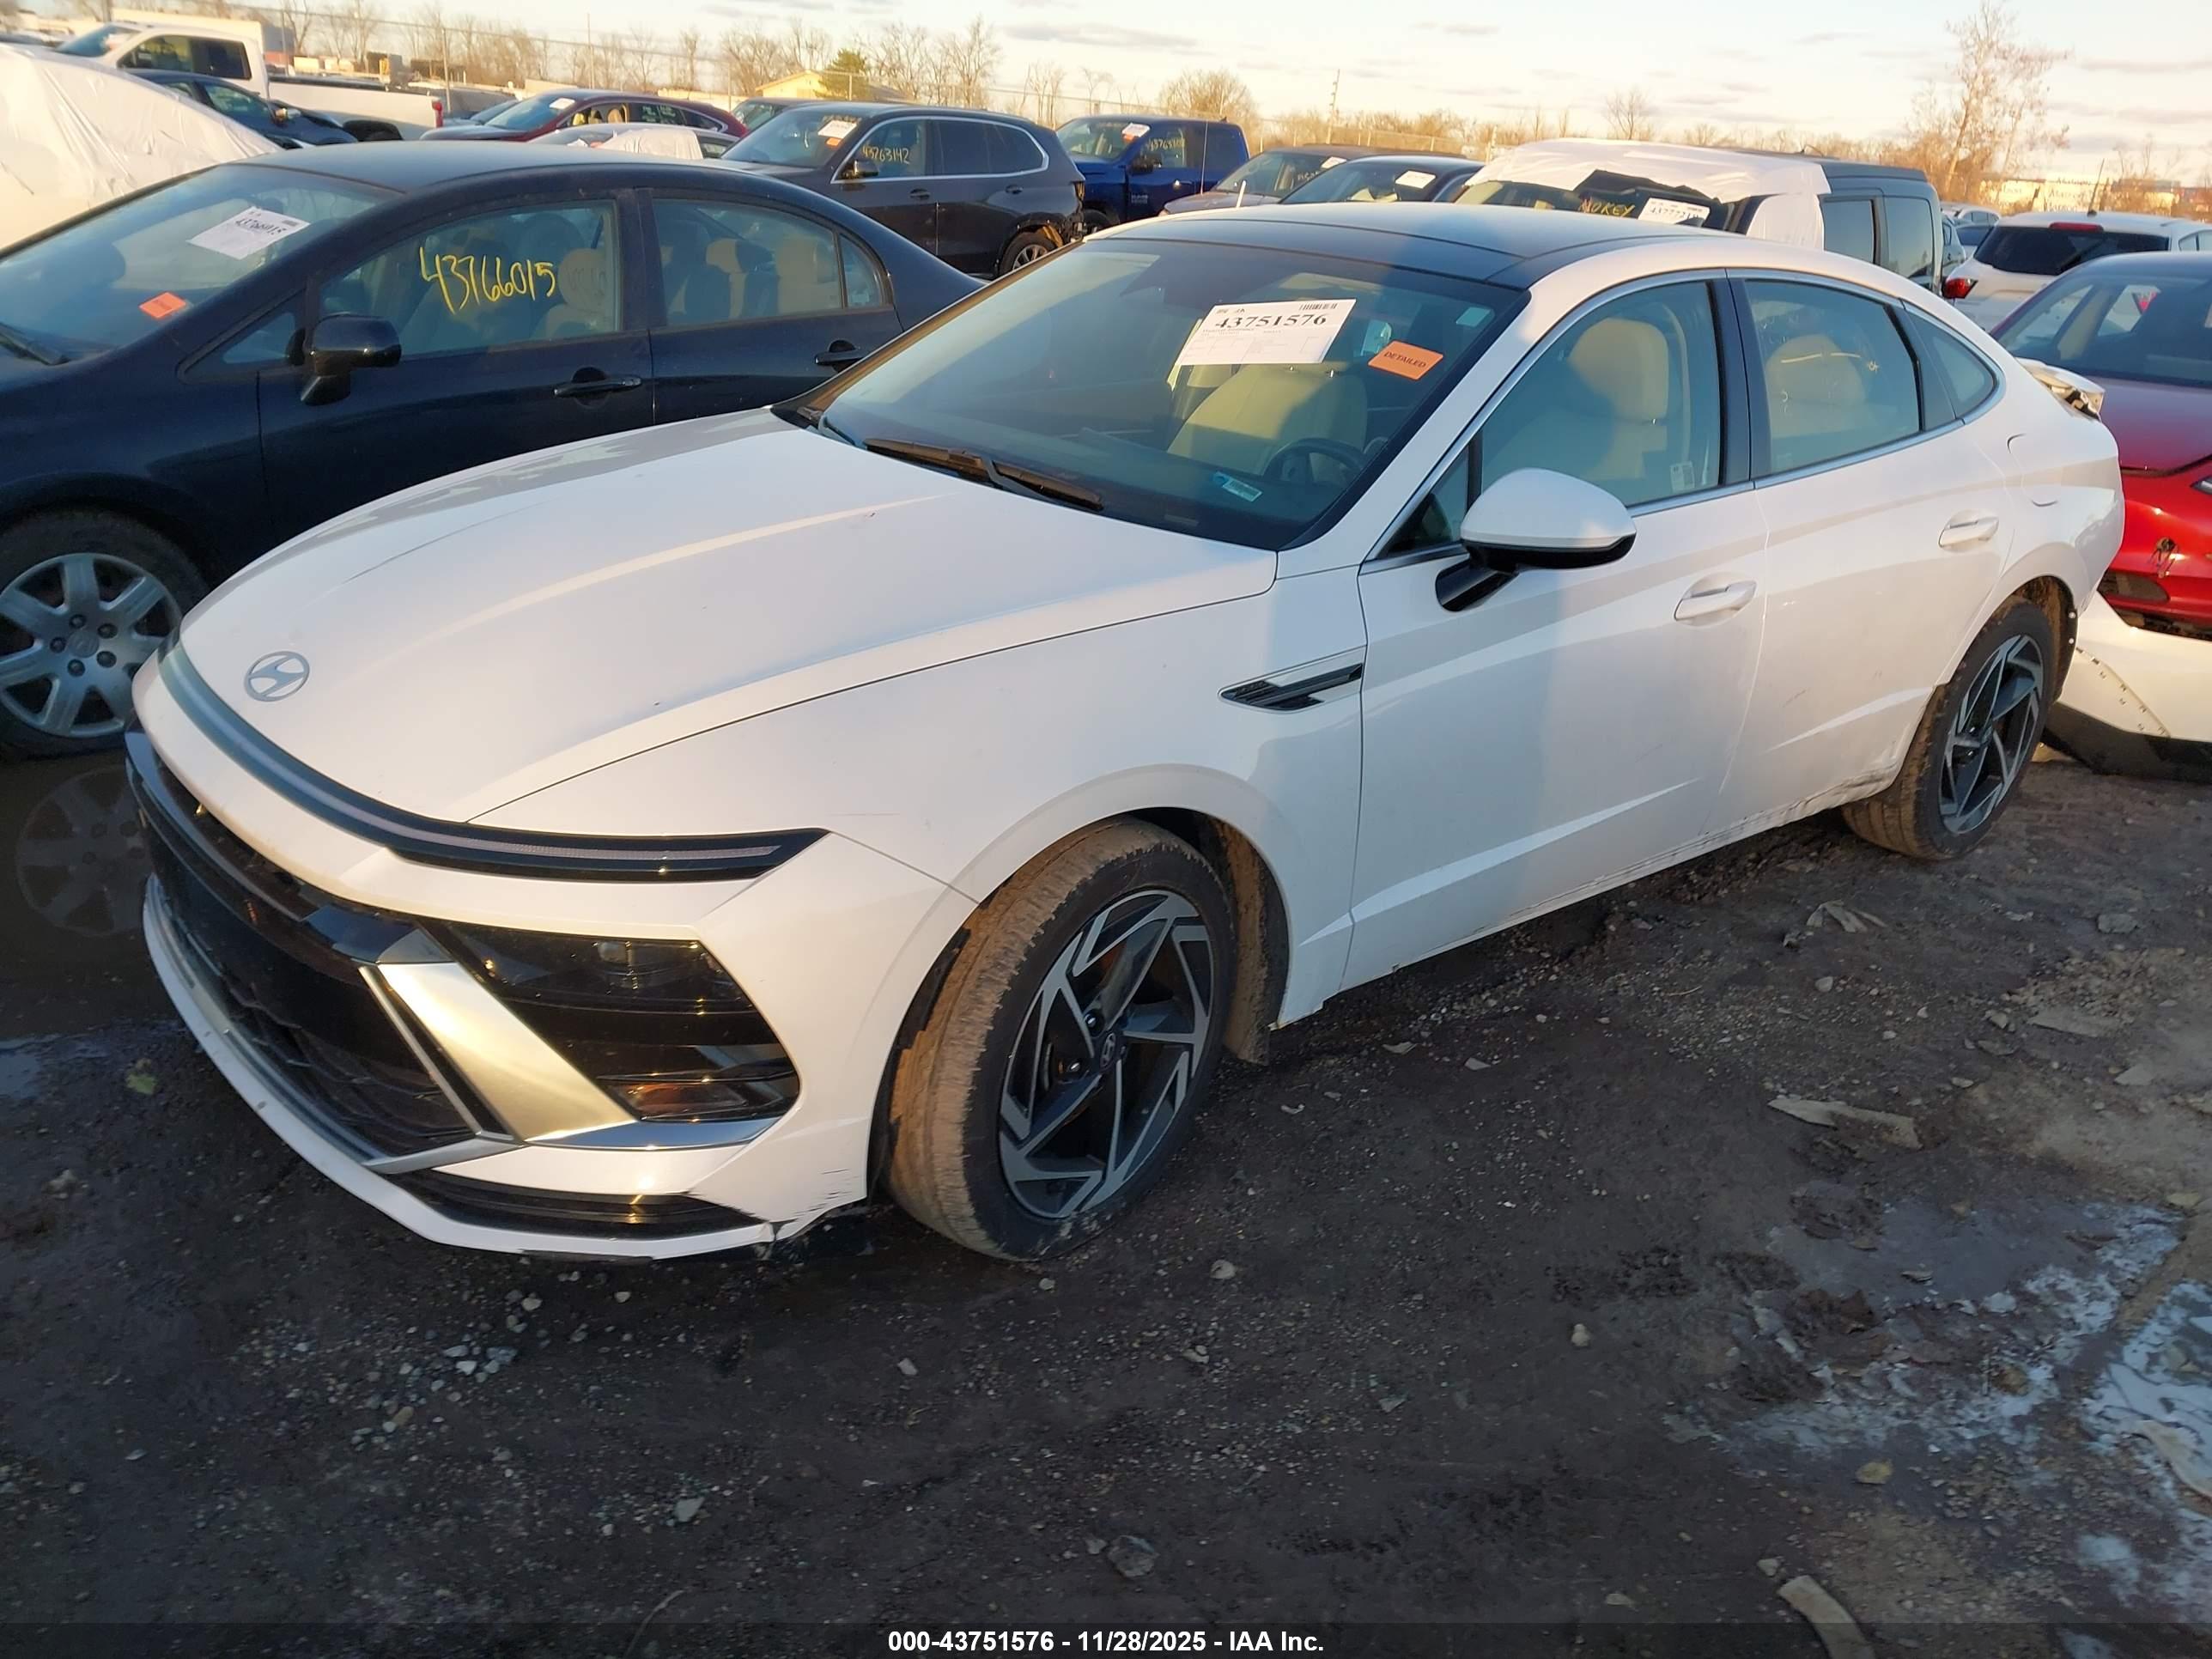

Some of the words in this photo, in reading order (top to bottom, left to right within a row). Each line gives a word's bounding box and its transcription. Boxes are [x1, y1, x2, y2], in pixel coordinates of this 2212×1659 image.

[862, 145, 909, 164] 43763142
[419, 246, 557, 315] 43766015
[1215, 313, 1328, 329] 43751576
[1383, 350, 1427, 368] DETAILED
